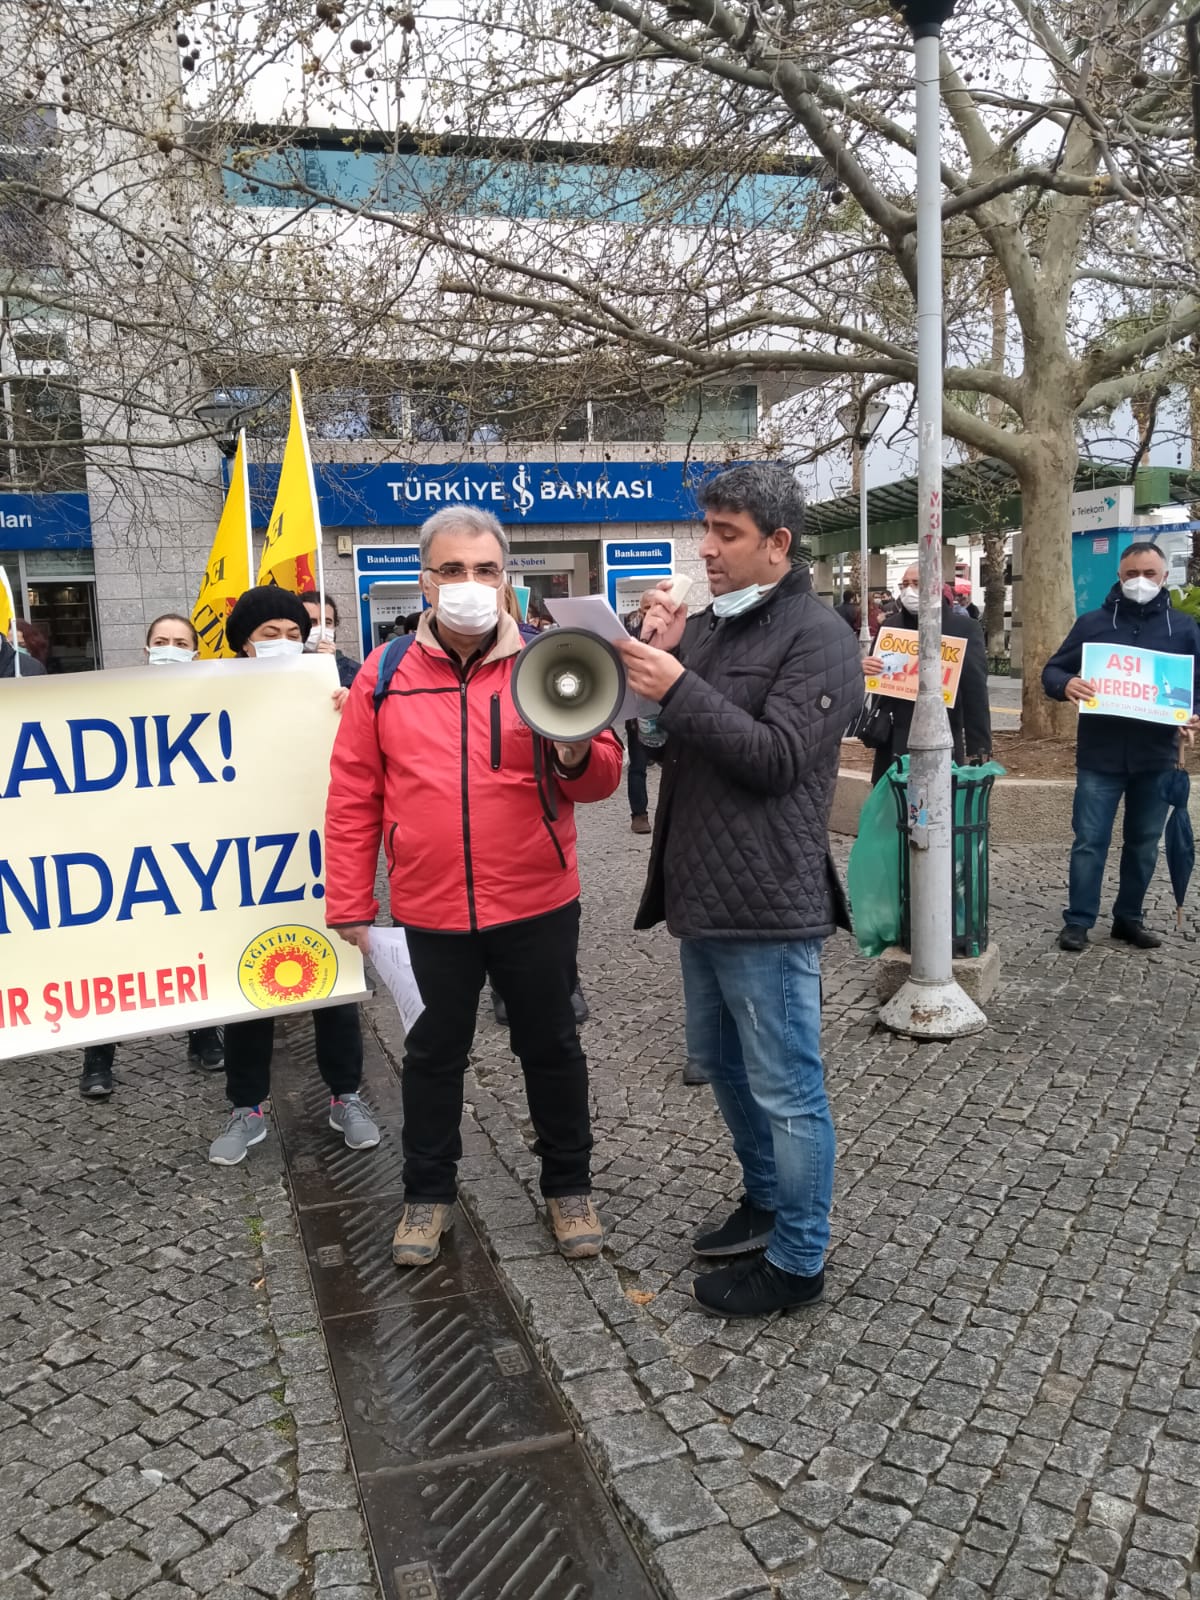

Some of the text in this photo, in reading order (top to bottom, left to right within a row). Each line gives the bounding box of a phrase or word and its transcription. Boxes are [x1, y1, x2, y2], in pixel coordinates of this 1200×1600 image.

[387, 477, 506, 501] TÜRKİYE
[541, 480, 652, 500] BANKASI
[1077, 505, 1104, 515] Telekom
[366, 554, 420, 564] Bankamatik
[614, 548, 663, 558] Bankamatik
[880, 633, 960, 663] ÖNCİK
[1106, 654, 1141, 676] AŞI
[1088, 678, 1158, 703] NEREDE?
[0, 709, 237, 799] ADIK!
[0, 829, 325, 934] NDAYIZ!
[244, 932, 330, 969] EĞİTİM SEN
[43, 952, 208, 1033] ŞUBELERİ
